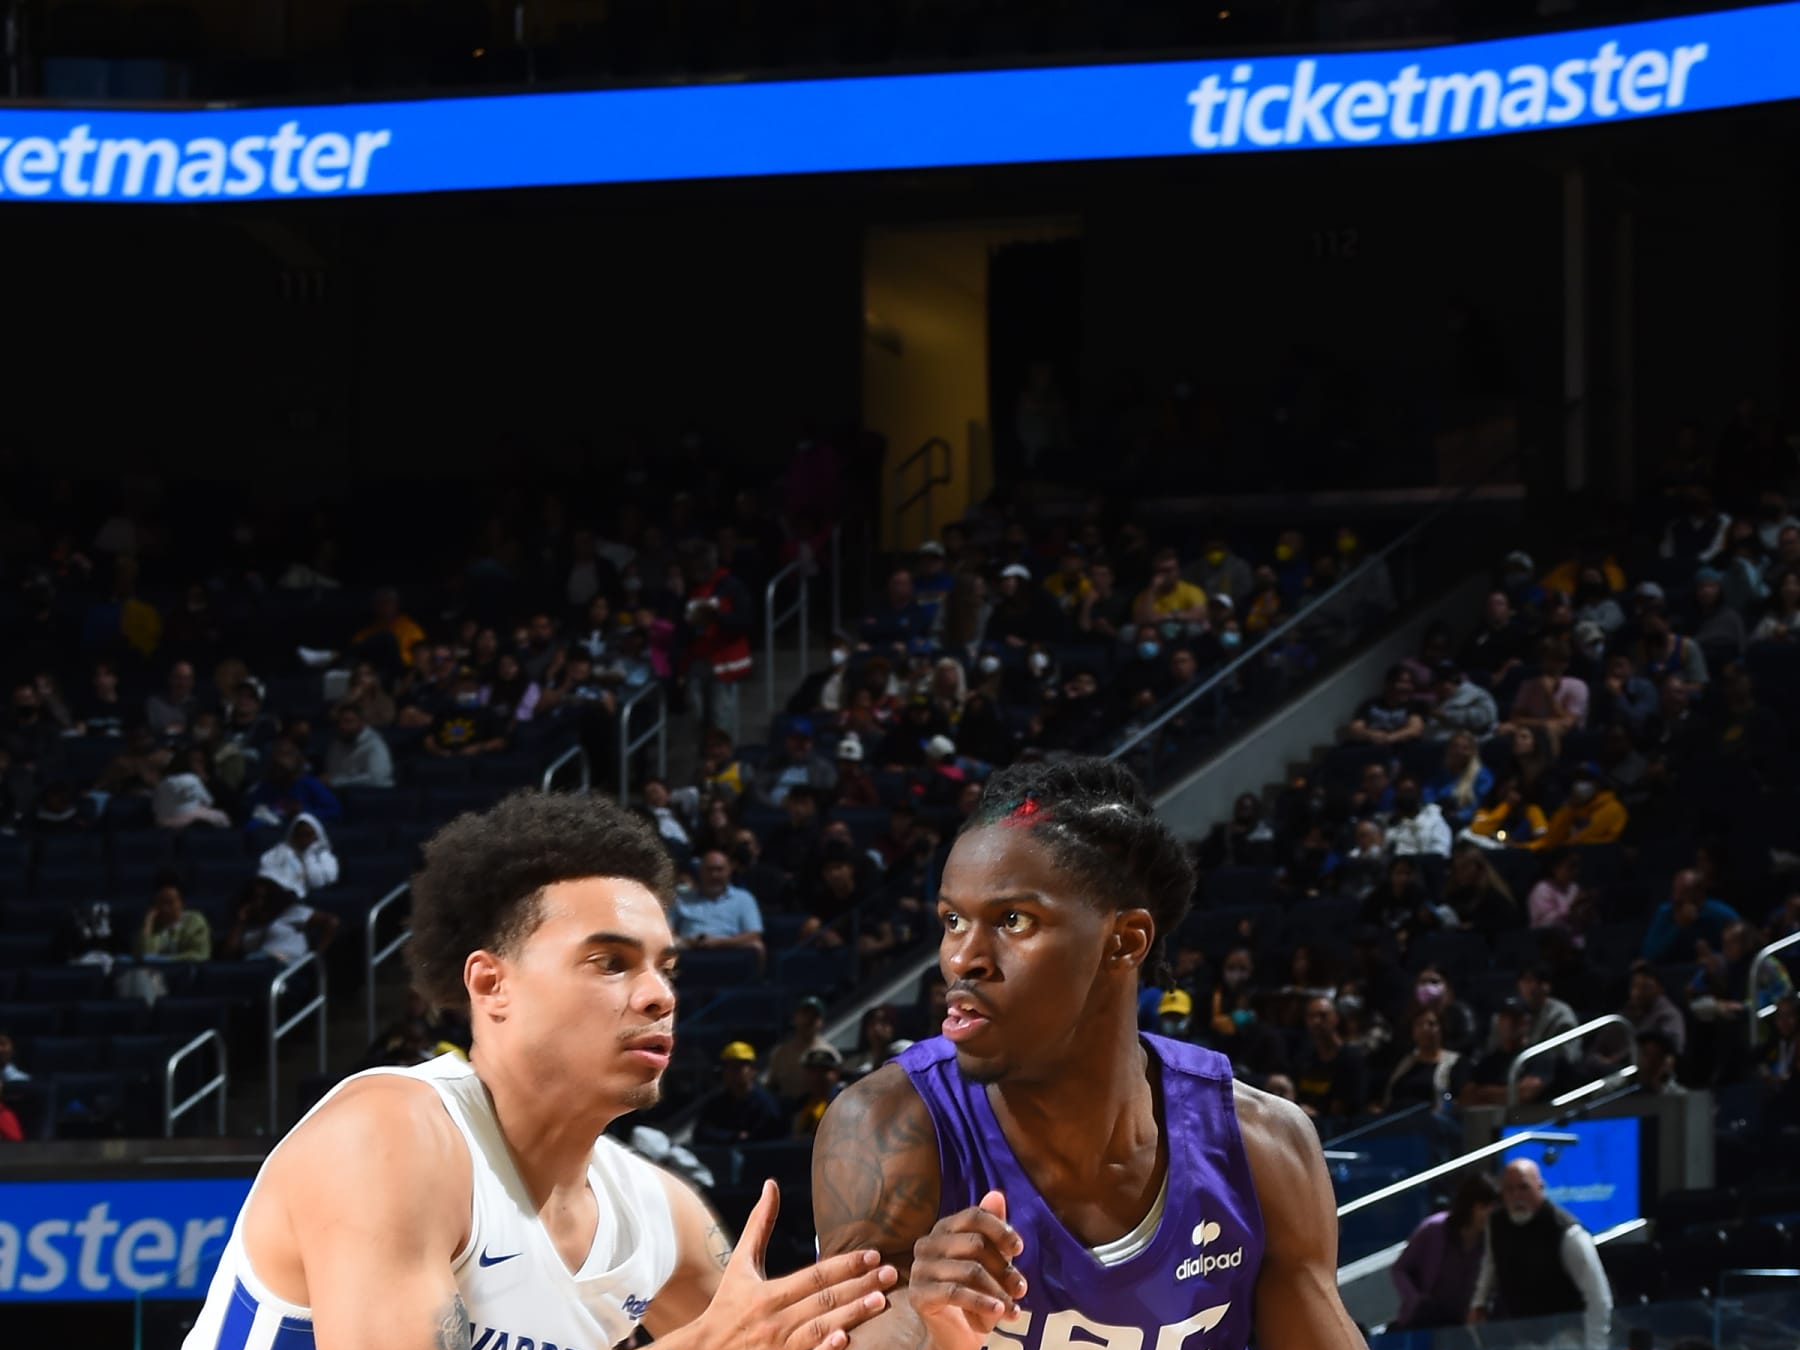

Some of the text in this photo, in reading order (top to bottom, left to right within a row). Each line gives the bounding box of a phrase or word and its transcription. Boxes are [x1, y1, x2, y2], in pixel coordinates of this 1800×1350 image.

[1187, 40, 1708, 149] ticketmaster
[0, 121, 391, 197] etmaster
[1176, 1247, 1243, 1281] dialpad
